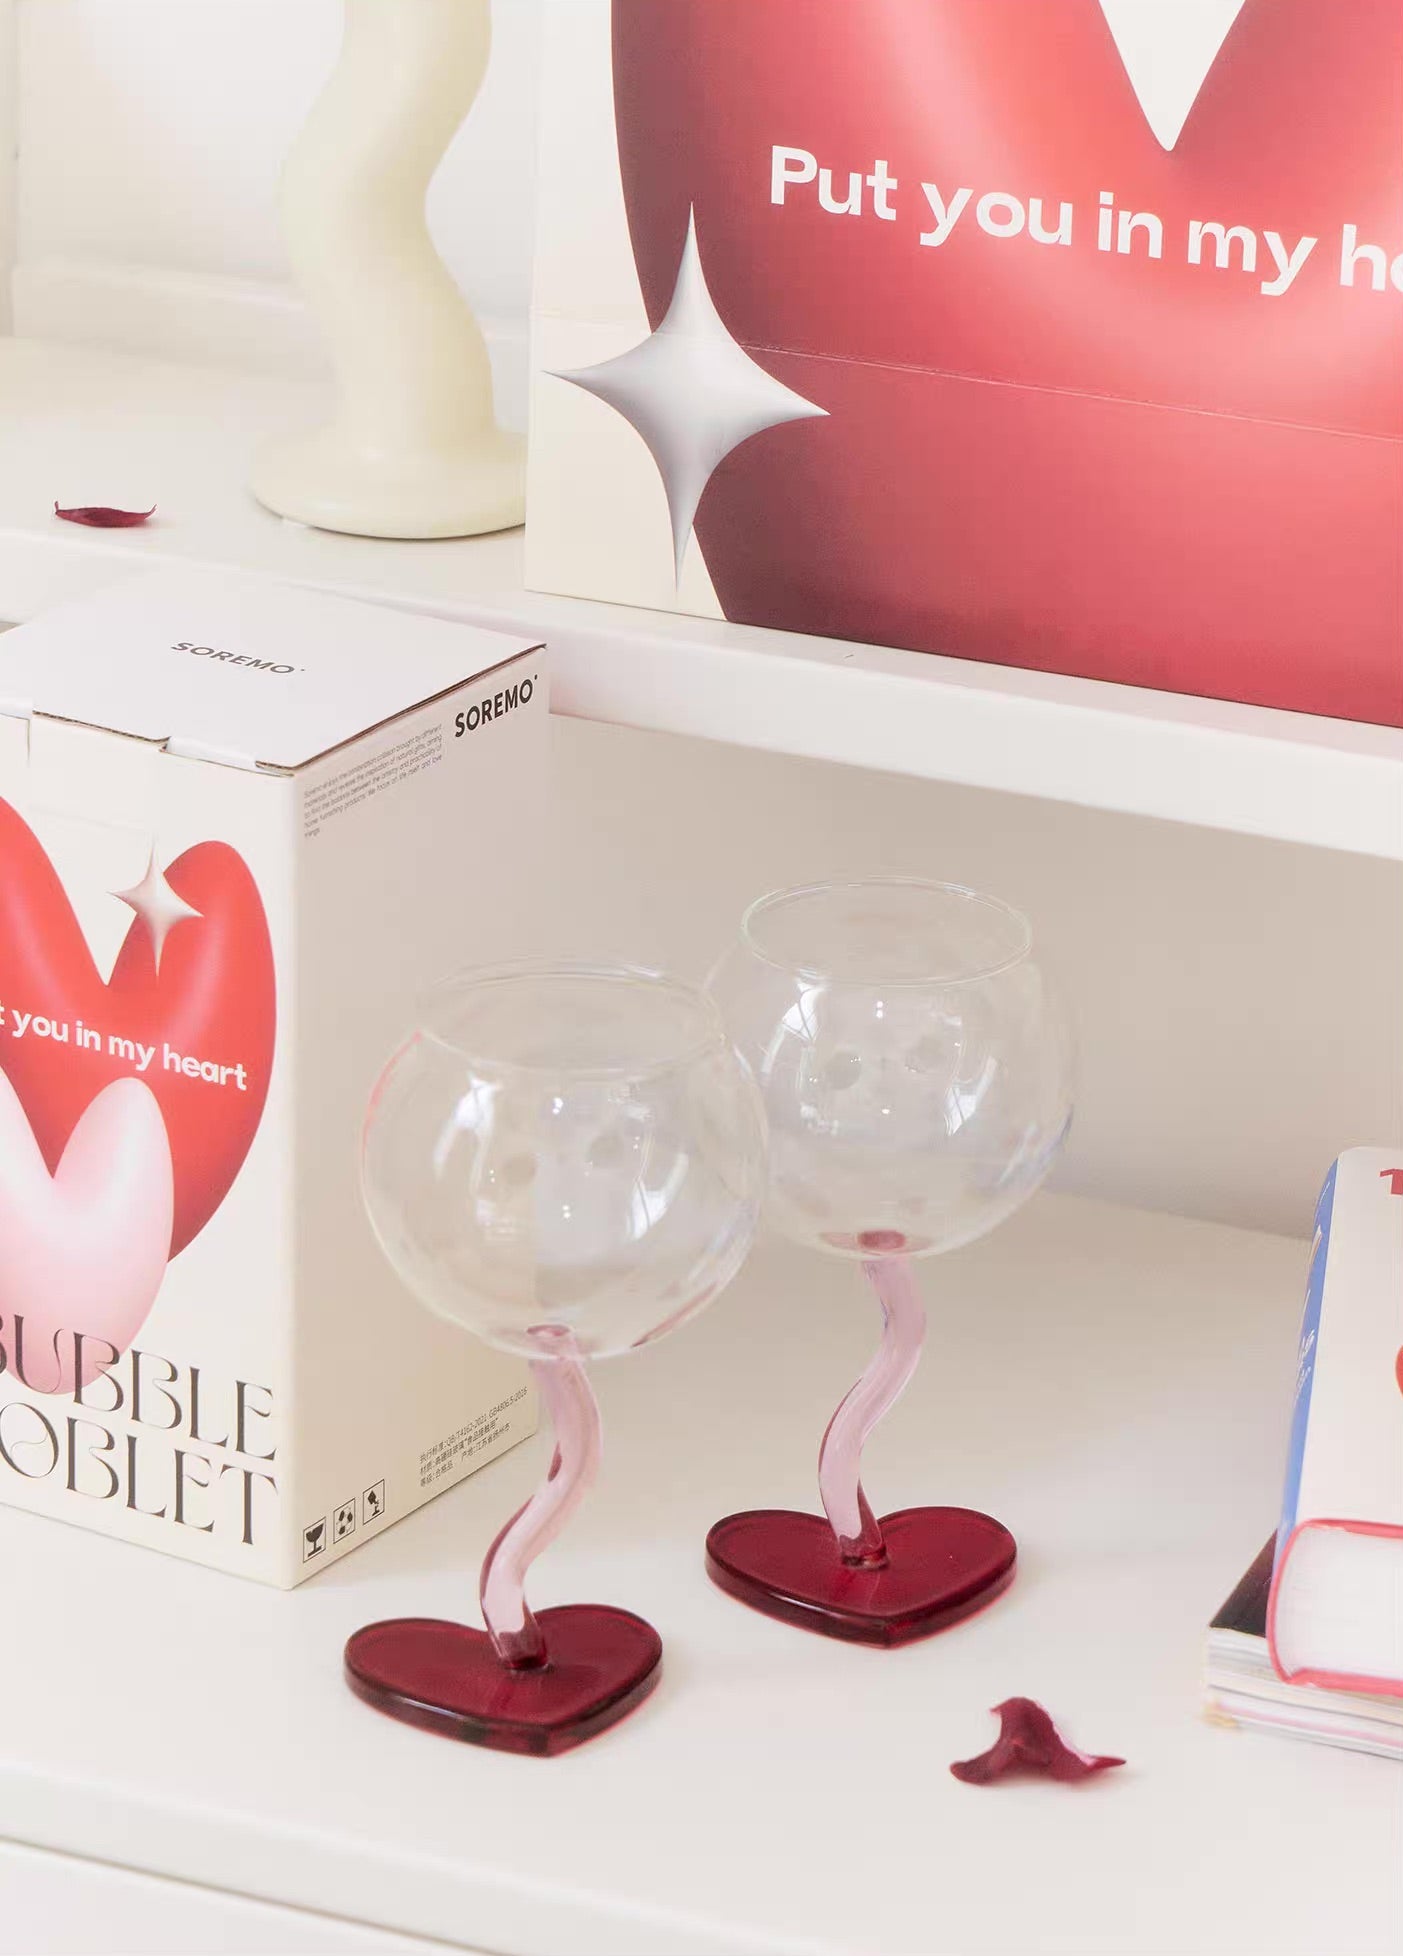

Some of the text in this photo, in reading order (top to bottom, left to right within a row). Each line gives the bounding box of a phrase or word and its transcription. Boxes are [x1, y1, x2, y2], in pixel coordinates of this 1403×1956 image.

[770, 145, 898, 221] Put
[919, 182, 1073, 248] you
[1097, 191, 1162, 259] in
[1187, 219, 1318, 297] my
[171, 642, 295, 674] SOREMO
[455, 678, 534, 738] SOREMO
[12, 1010, 69, 1043] you
[76, 1020, 101, 1052] in
[108, 1035, 156, 1072] my
[163, 1042, 247, 1091] heart
[0, 1402, 279, 1545] OBLET
